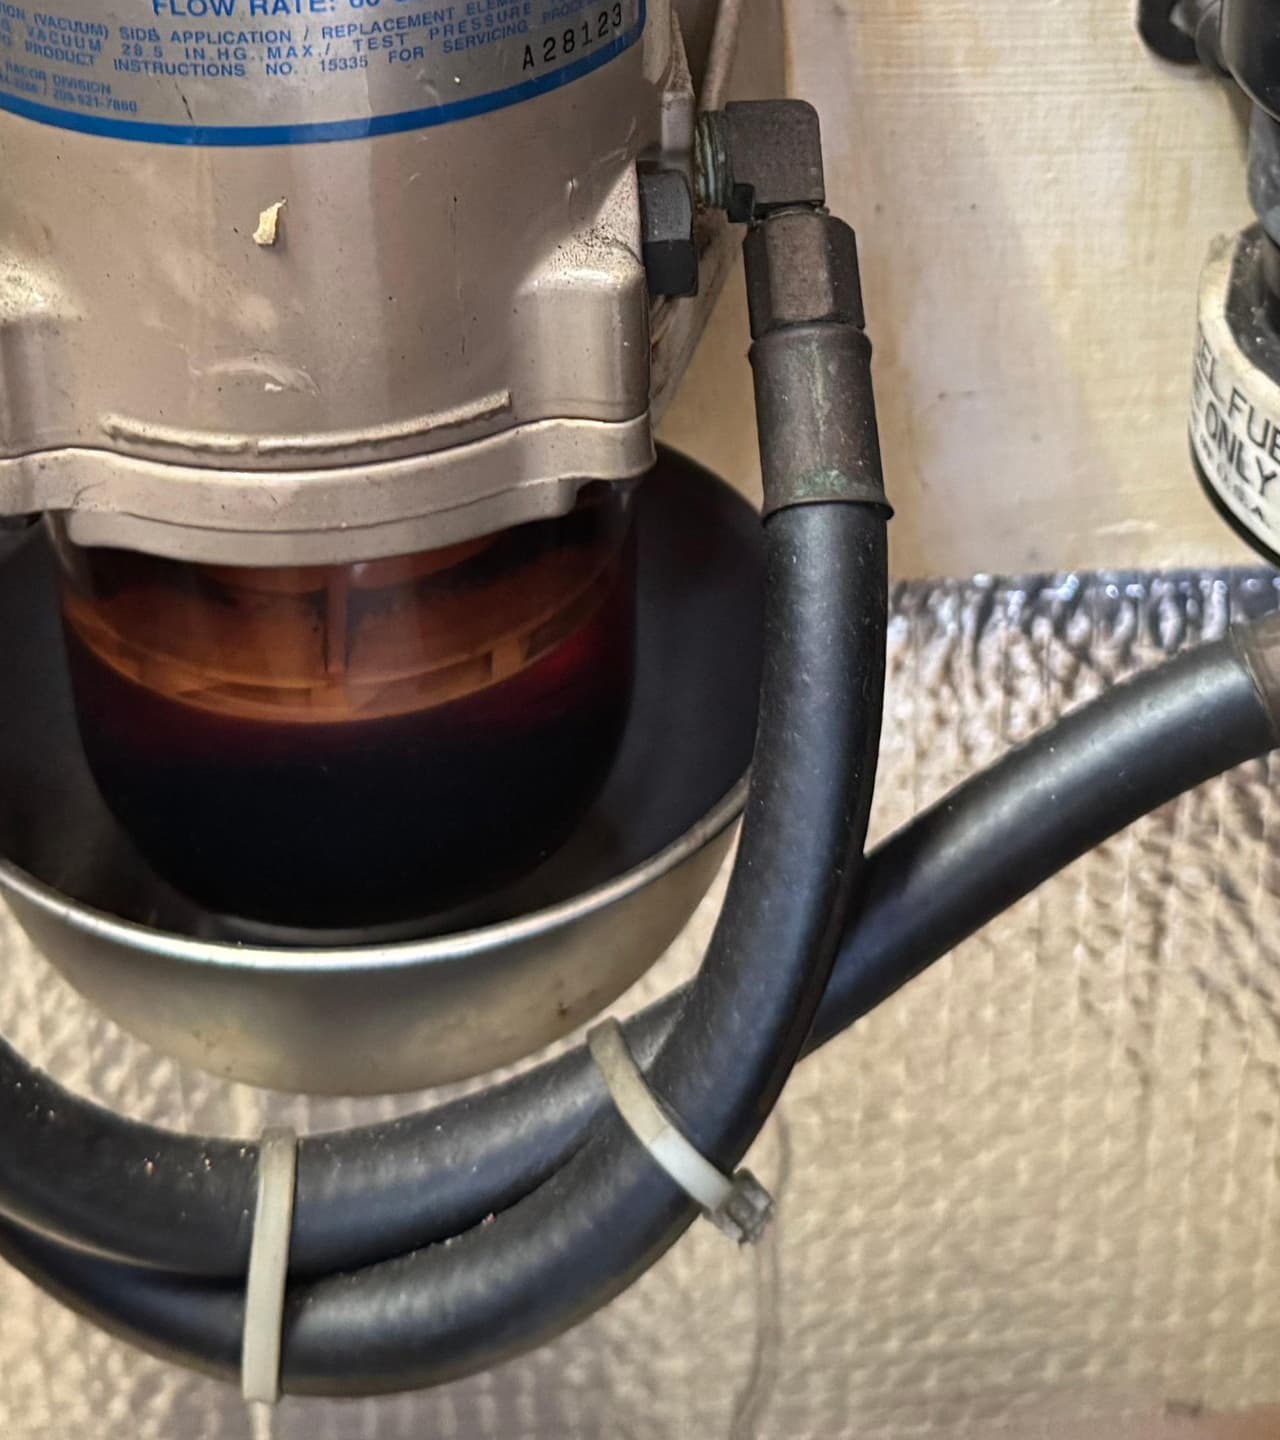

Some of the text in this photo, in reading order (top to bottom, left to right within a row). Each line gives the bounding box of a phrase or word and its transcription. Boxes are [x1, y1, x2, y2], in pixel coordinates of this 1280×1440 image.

[24, 39, 96, 66] PRODUCT
[113, 57, 247, 78] INSTRUCTIONS
[265, 61, 299, 76] NO.
[320, 56, 369, 73] 15335
[387, 46, 425, 64] FOR
[442, 19, 529, 54] SERVICING
[27, 26, 102, 52] VACUUM
[353, 32, 409, 53] TEST
[429, 1, 532, 41] PRESSURE
[33, 13, 109, 40] (VACUUM)
[119, 26, 161, 44] SIDE
[169, 28, 293, 46] APPLICATION
[321, 7, 456, 40] REPLACEMENT
[1204, 401, 1278, 498] ONLY
